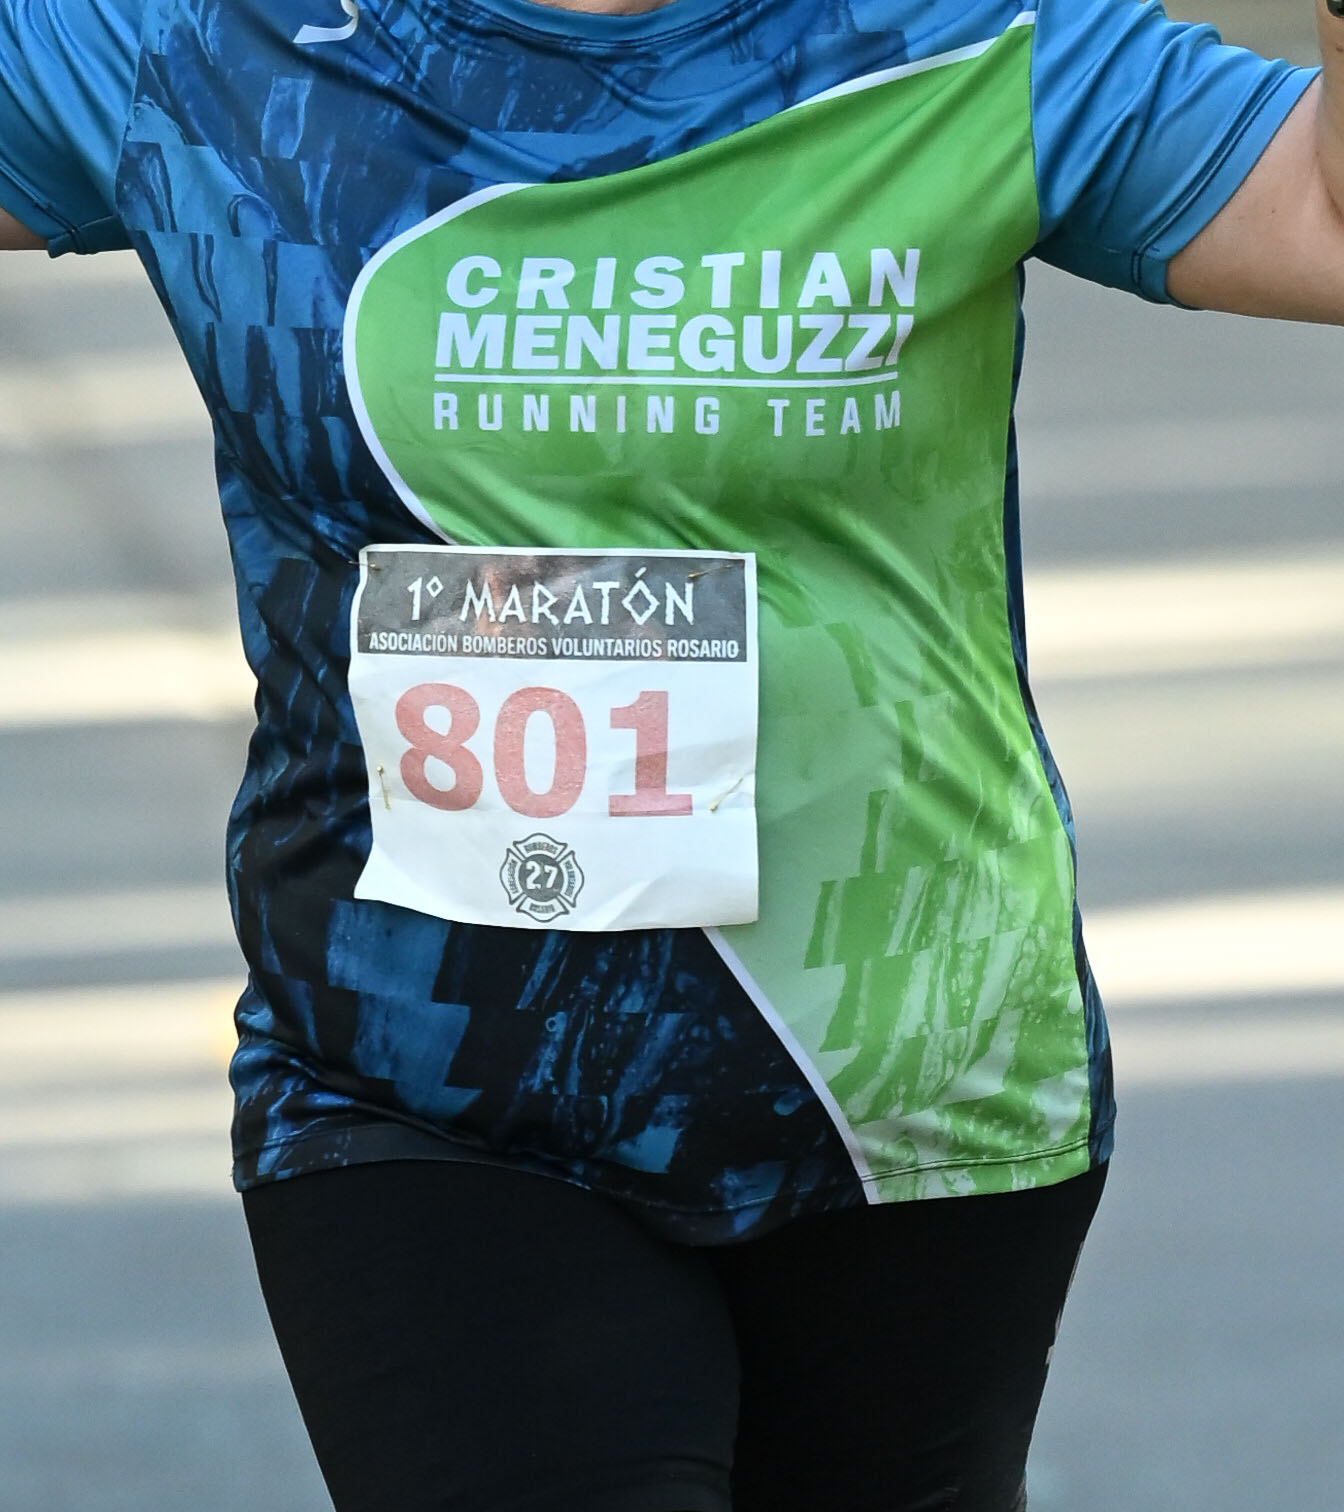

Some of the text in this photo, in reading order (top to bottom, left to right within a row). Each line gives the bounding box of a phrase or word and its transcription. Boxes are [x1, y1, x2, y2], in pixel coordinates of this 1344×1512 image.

[445, 248, 921, 310] CRISTIAN
[434, 313, 915, 374] MENEGUZZI
[434, 390, 902, 437] RUNNING TEAM
[459, 566, 694, 626] MARATÓN
[462, 635, 547, 656] BOMBEROS
[552, 638, 662, 658] VOLUNTARIOS
[667, 639, 739, 659] ROSARIO
[394, 682, 693, 819] 801
[526, 860, 558, 890] 27
